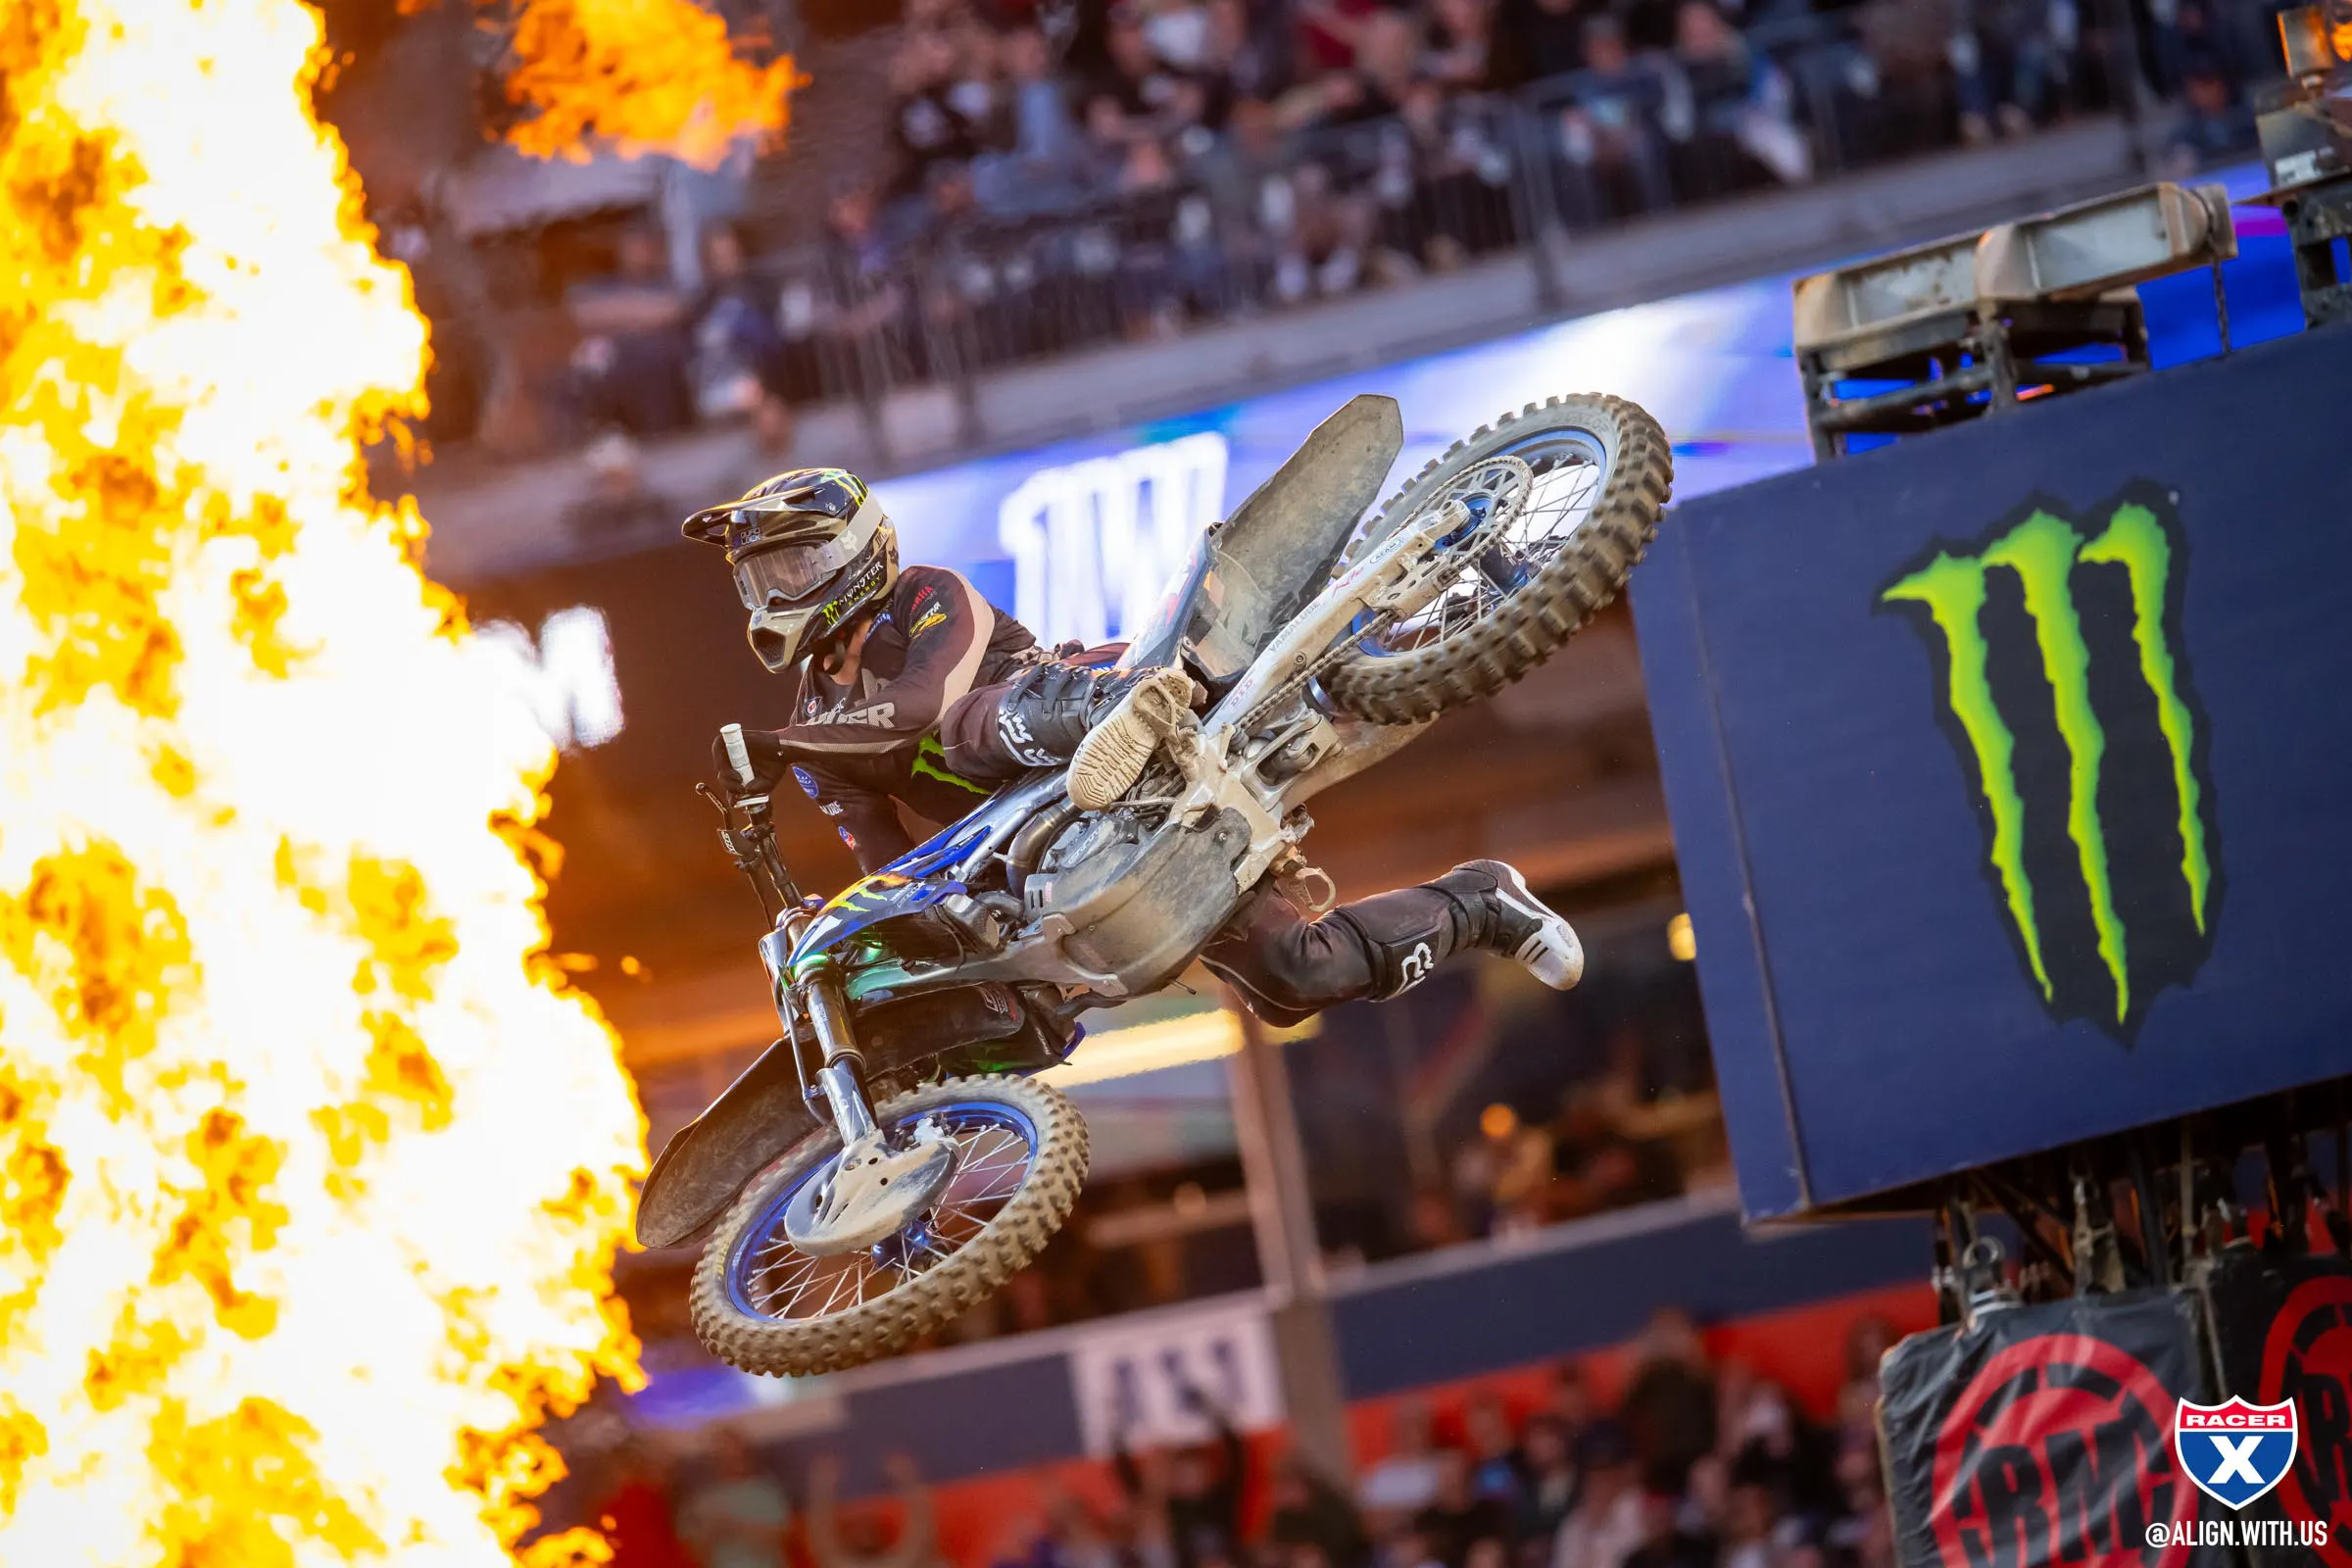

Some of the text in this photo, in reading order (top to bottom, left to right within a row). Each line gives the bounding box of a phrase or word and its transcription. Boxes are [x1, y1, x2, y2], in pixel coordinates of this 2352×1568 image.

[839, 561, 884, 606] MONSTER
[848, 576, 881, 607] ENERGY
[1268, 600, 1321, 652] YAMALUBE
